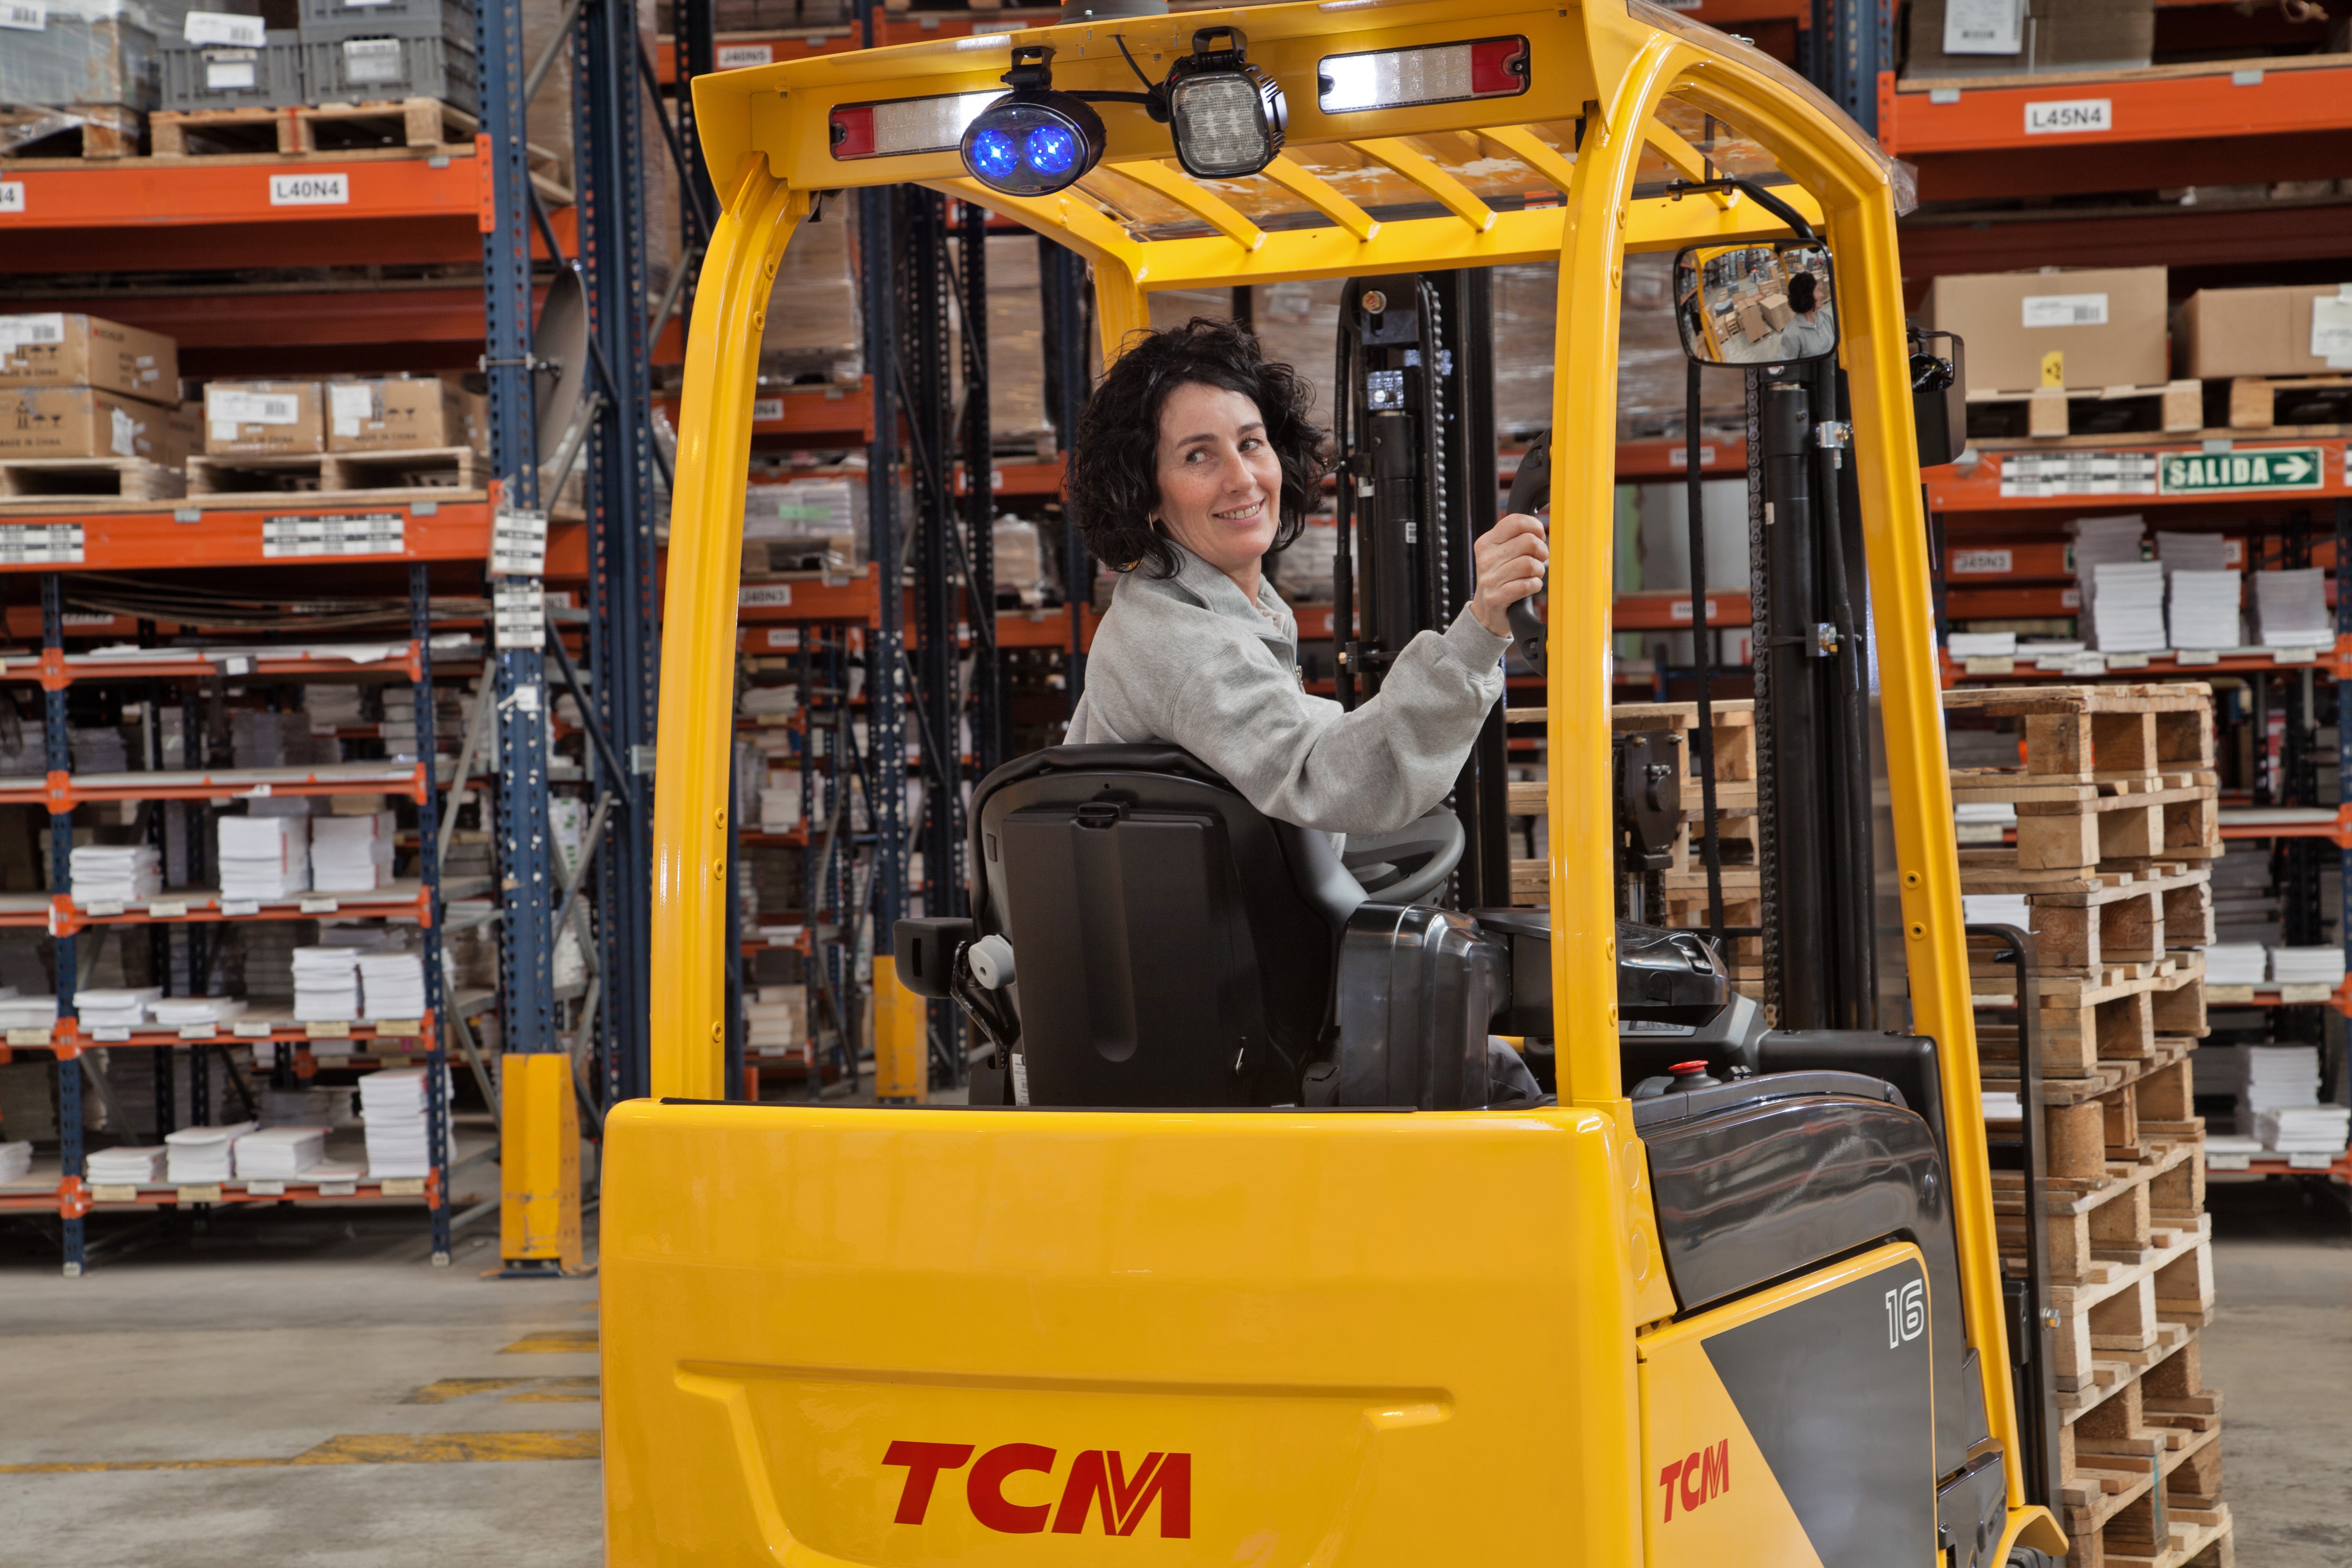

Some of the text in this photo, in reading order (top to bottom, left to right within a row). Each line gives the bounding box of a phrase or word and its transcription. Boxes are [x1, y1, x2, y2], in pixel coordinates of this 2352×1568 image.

[2033, 106, 2102, 127] L45N4
[277, 180, 338, 198] L40N4
[2170, 457, 2270, 486] SALIDA
[1885, 1279, 1924, 1349] 16
[881, 1440, 1191, 1539] TCM
[1659, 1438, 1730, 1524] TCM
